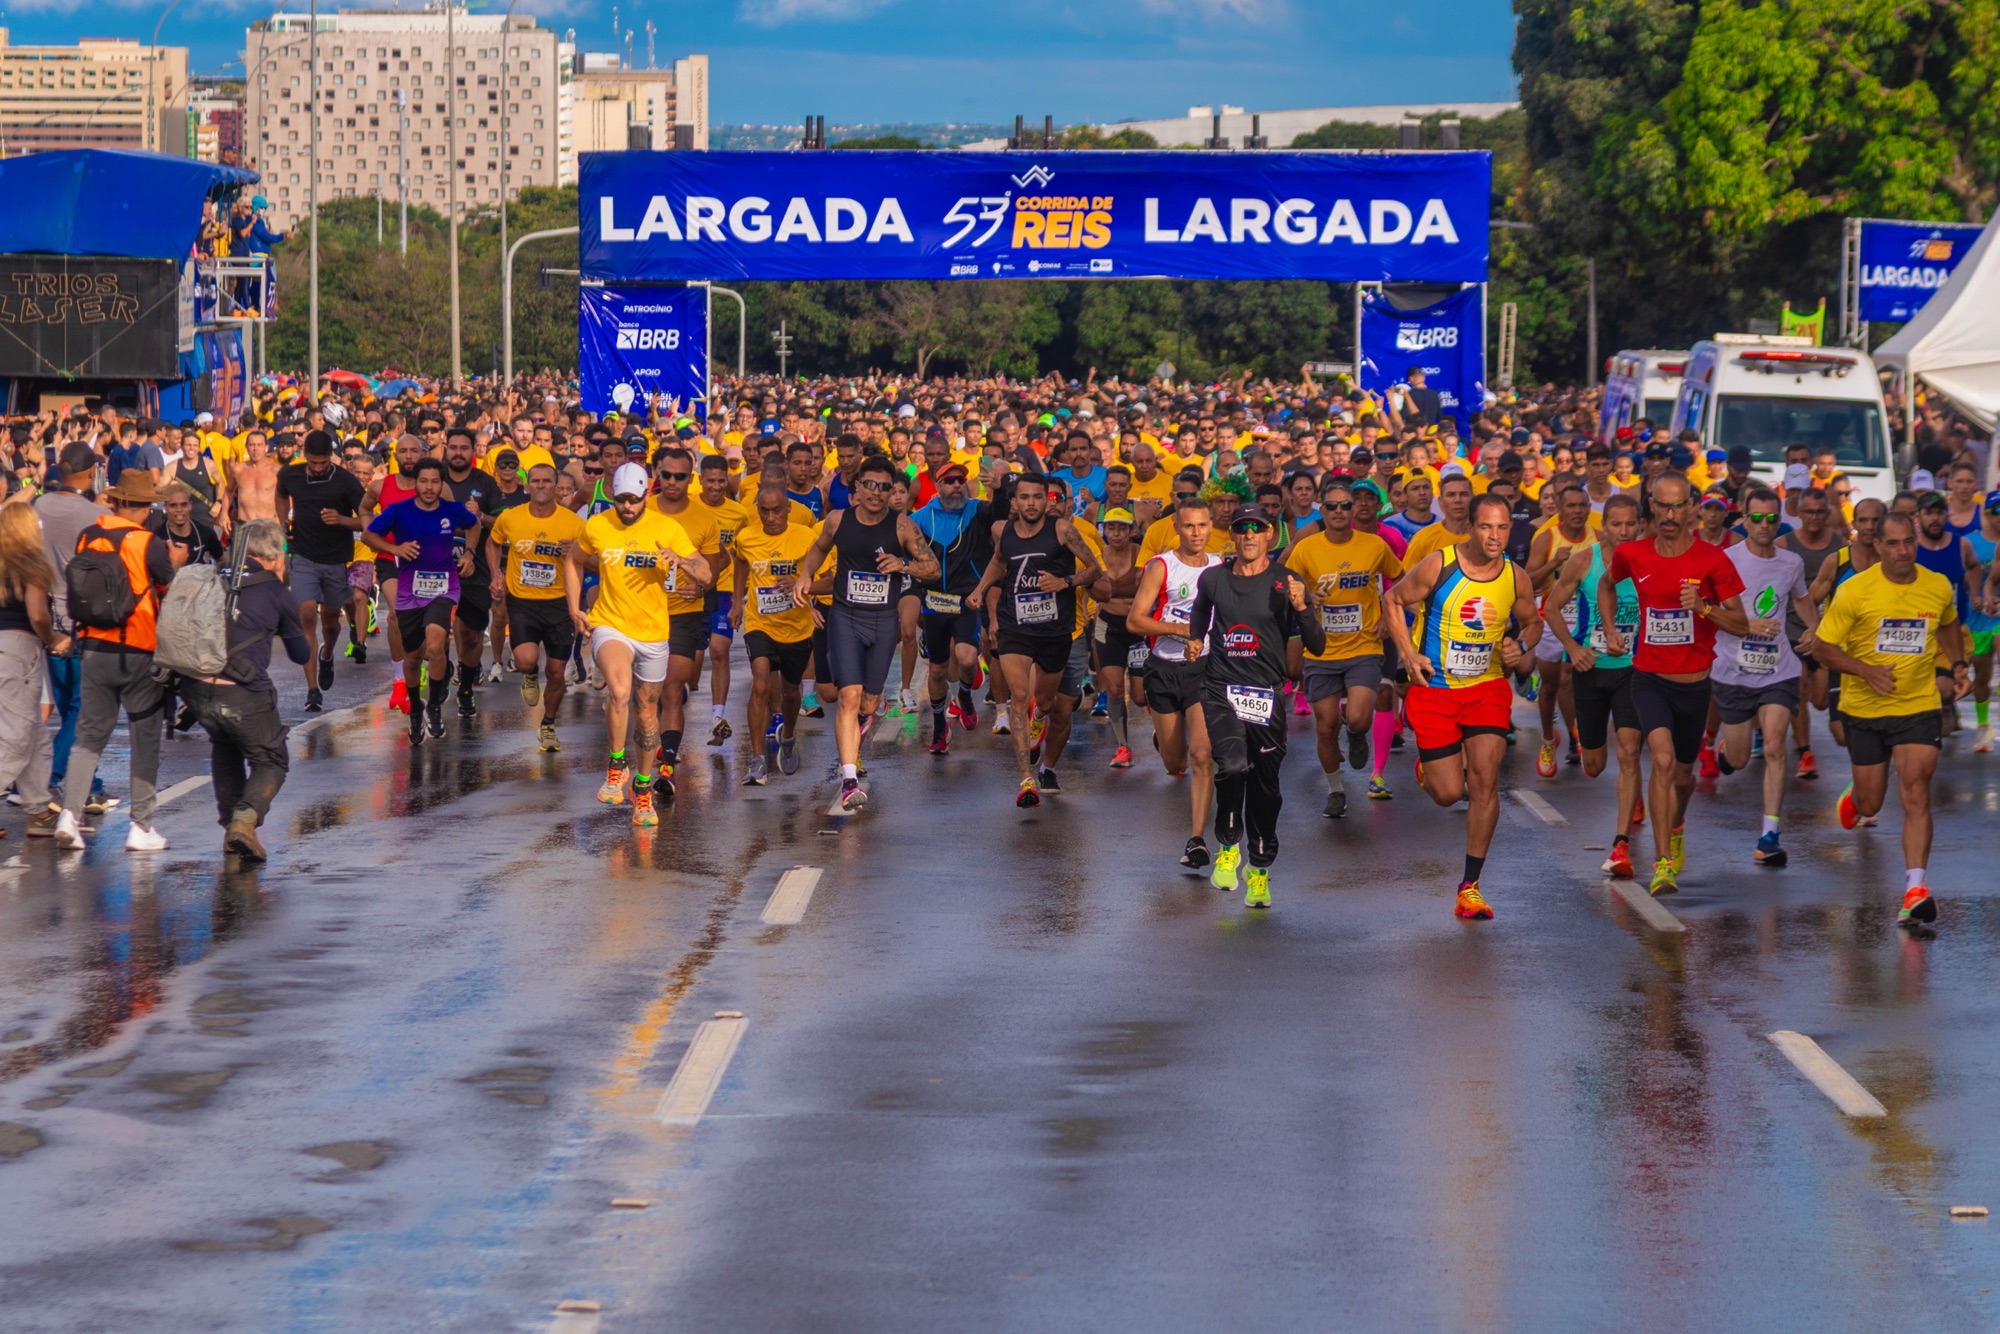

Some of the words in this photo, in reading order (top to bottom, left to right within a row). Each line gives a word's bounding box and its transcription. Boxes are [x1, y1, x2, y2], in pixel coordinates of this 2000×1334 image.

[1015, 196, 1089, 210] CORRIDA
[1091, 196, 1114, 210] DE
[600, 195, 914, 243] LARGADA
[1144, 197, 1460, 245] LARGADA
[1011, 210, 1113, 249] REIS
[1861, 264, 1950, 289] LARGADA
[12, 273, 119, 296] TRIOS
[0, 293, 139, 324] LASER
[623, 304, 673, 313] PATROCÍNIO
[638, 329, 680, 350] BRB
[1419, 327, 1459, 347] BRB
[643, 392, 673, 401] BRSIL
[720, 534, 734, 544] EIS
[534, 545, 563, 557] REIS
[624, 555, 657, 568] REIS
[525, 569, 552, 579] 13856
[770, 564, 798, 575] REIS
[418, 581, 443, 589] 11724
[853, 582, 884, 593] 10320
[1339, 575, 1370, 589] REIS
[1021, 602, 1051, 614] 14618
[1326, 614, 1357, 625] 15392
[1650, 621, 1685, 633] 15431
[1223, 632, 1254, 643] VÍCIO
[1465, 631, 1486, 639] CAPI
[1884, 630, 1921, 641] 14087
[1454, 653, 1488, 665] 11905
[1743, 652, 1776, 665] 13700
[1234, 697, 1269, 713] 14650
